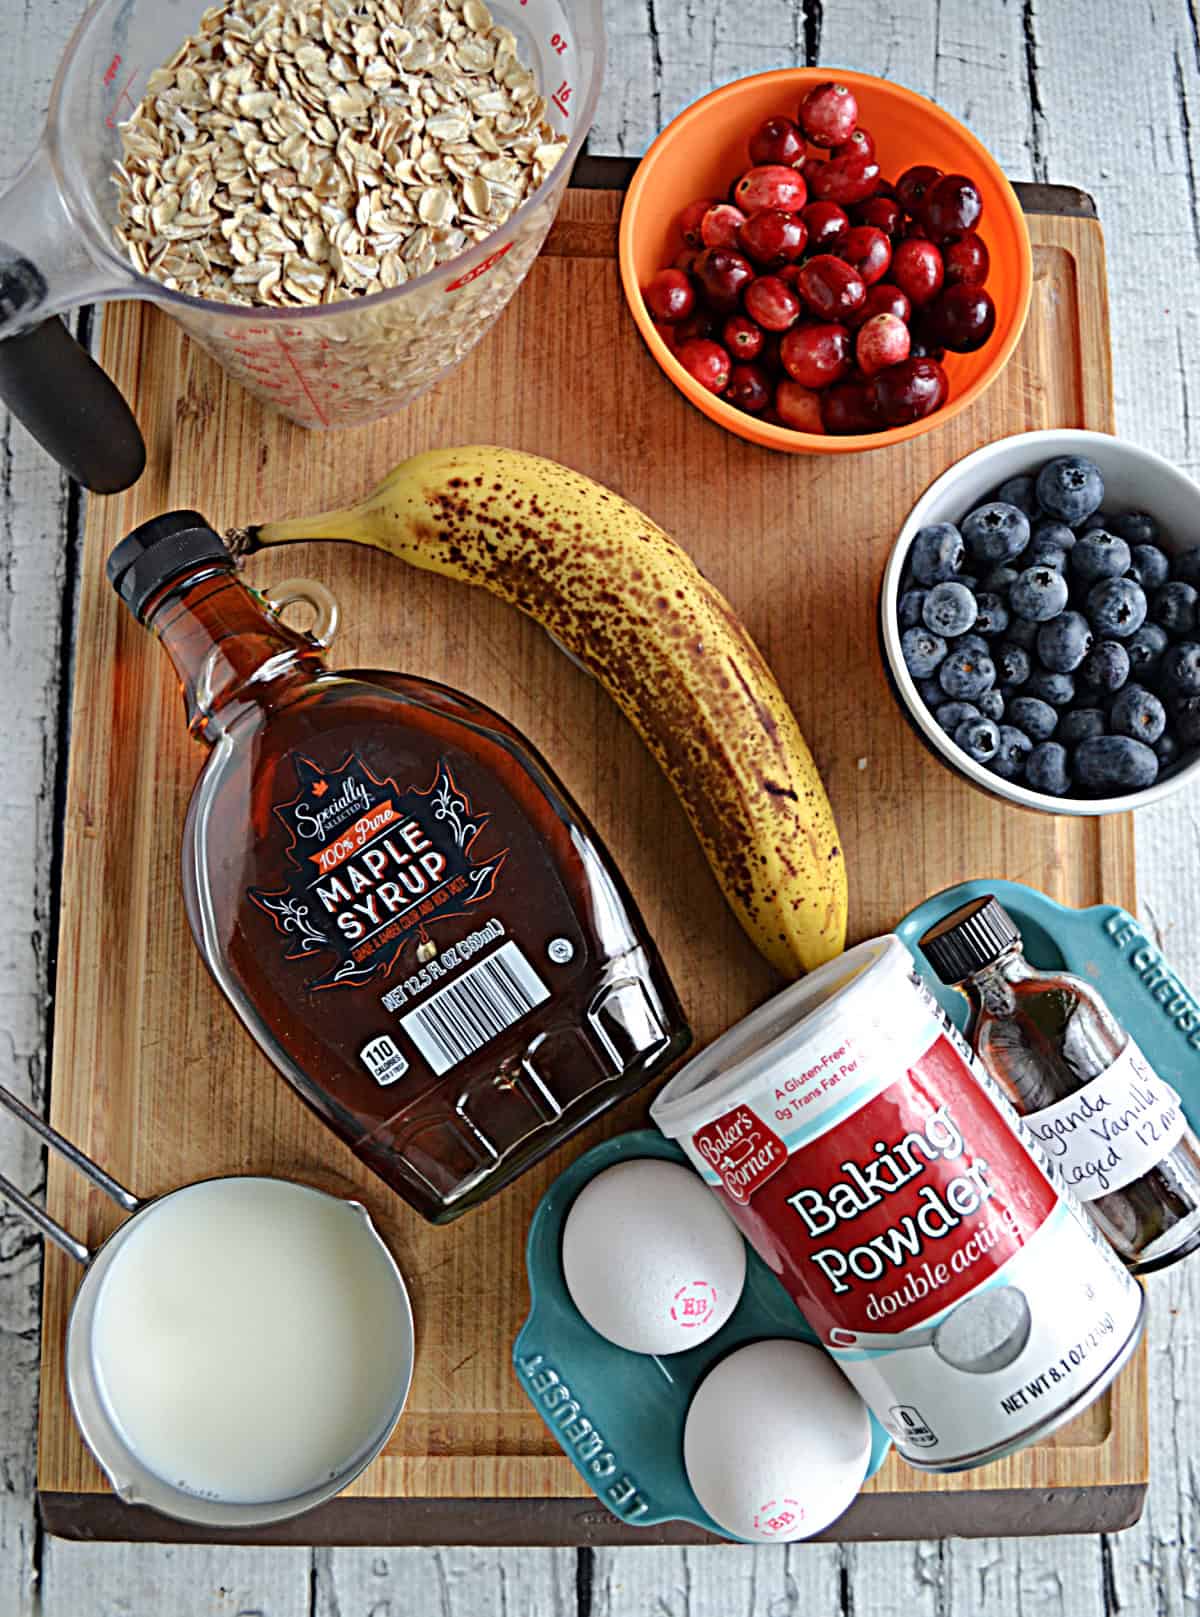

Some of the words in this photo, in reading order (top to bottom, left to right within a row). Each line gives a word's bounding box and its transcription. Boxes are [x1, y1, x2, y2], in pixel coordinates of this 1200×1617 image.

[295, 776, 372, 842] Specially
[320, 838, 354, 871] 100%
[355, 808, 394, 846] Pure
[324, 802, 361, 831] SELECTED
[316, 821, 432, 913] MAPLE
[337, 851, 447, 940] SYRUP
[1103, 911, 1138, 949] LE
[381, 984, 409, 1013] NET
[404, 969, 432, 996] 12.5
[440, 948, 463, 970] OZ
[366, 1040, 394, 1066] 110
[774, 1088, 785, 1101] A
[784, 1046, 846, 1093] Gluten-Free
[775, 1107, 793, 1121] 0g
[789, 1087, 822, 1111] Trans
[820, 1073, 841, 1091] Fat
[839, 1060, 859, 1076] Per
[698, 1107, 753, 1166] Baker's
[1135, 1121, 1162, 1147] 12
[721, 1140, 776, 1199] Corner
[787, 1104, 965, 1238] Baking
[810, 1157, 995, 1294] Powder
[865, 1261, 951, 1321] double
[950, 1207, 1024, 1274] acting
[682, 1298, 708, 1316] EB
[1000, 1389, 1029, 1416] NET
[1025, 1373, 1051, 1398] WT
[1048, 1359, 1072, 1383] 8.1
[1068, 1343, 1086, 1366] OZ
[519, 1354, 617, 1477] CREUSET
[900, 1411, 914, 1426] 0
[606, 1477, 649, 1520] LE
